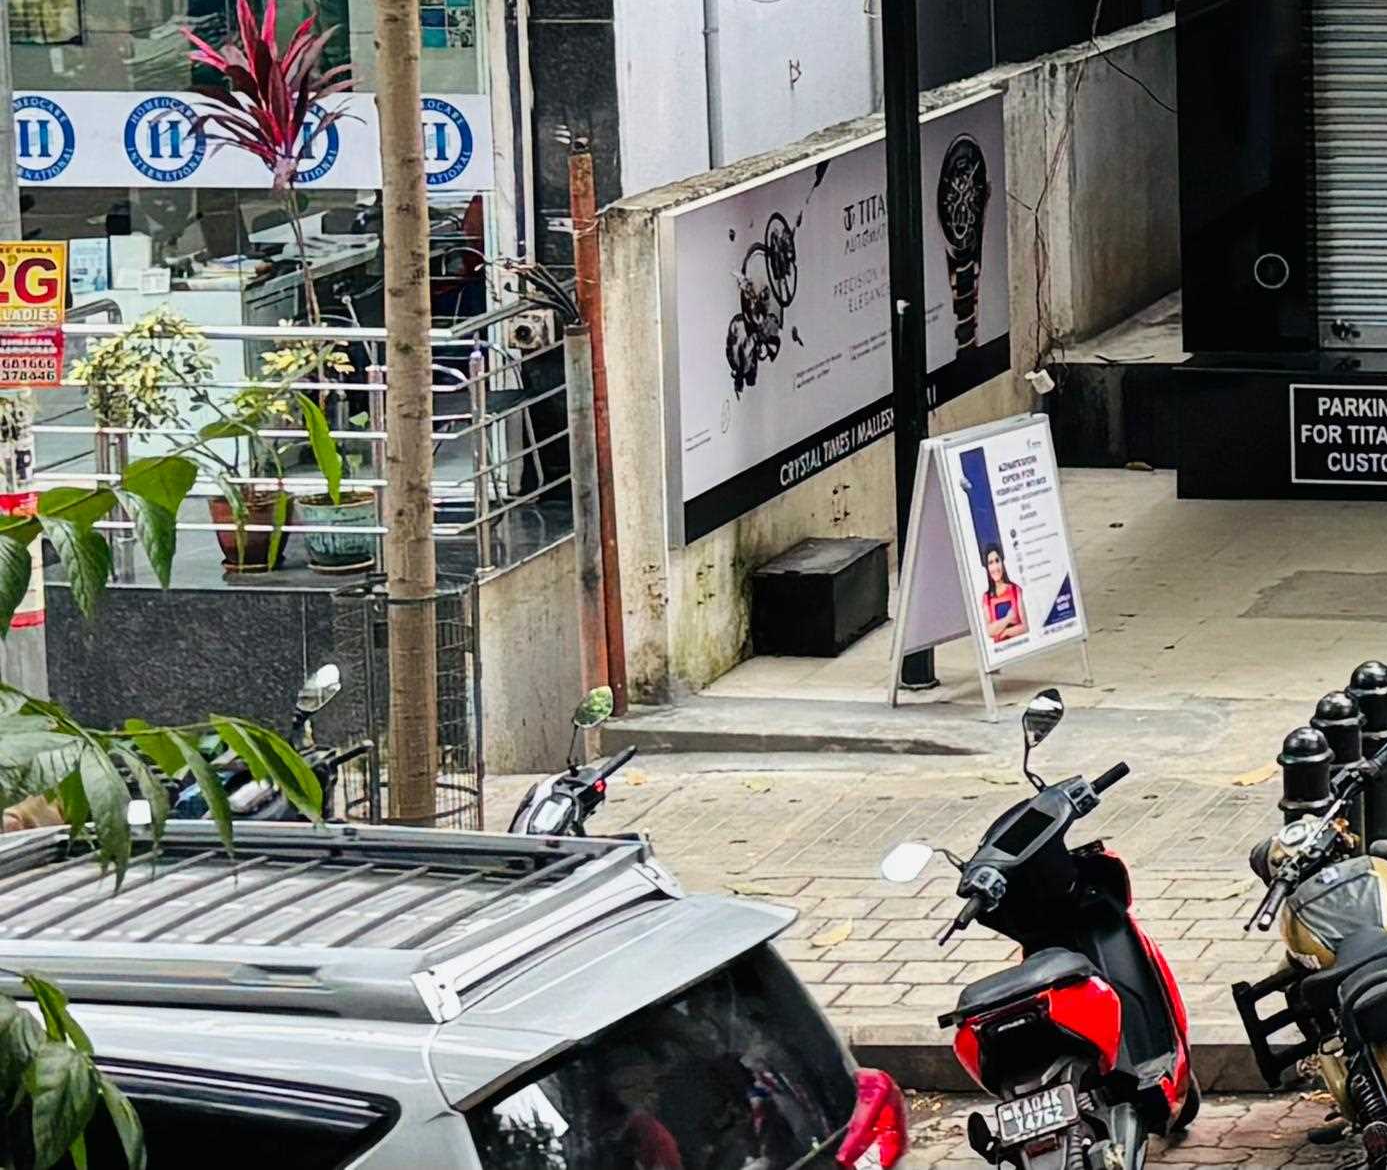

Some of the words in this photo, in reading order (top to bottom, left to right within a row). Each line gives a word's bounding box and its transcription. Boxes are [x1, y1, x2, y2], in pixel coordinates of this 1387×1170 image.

[858, 194, 886, 226] TITA
[1300, 424, 1342, 444] FOR
[780, 446, 821, 486] CRYSTAL
[823, 430, 850, 463] TIMES
